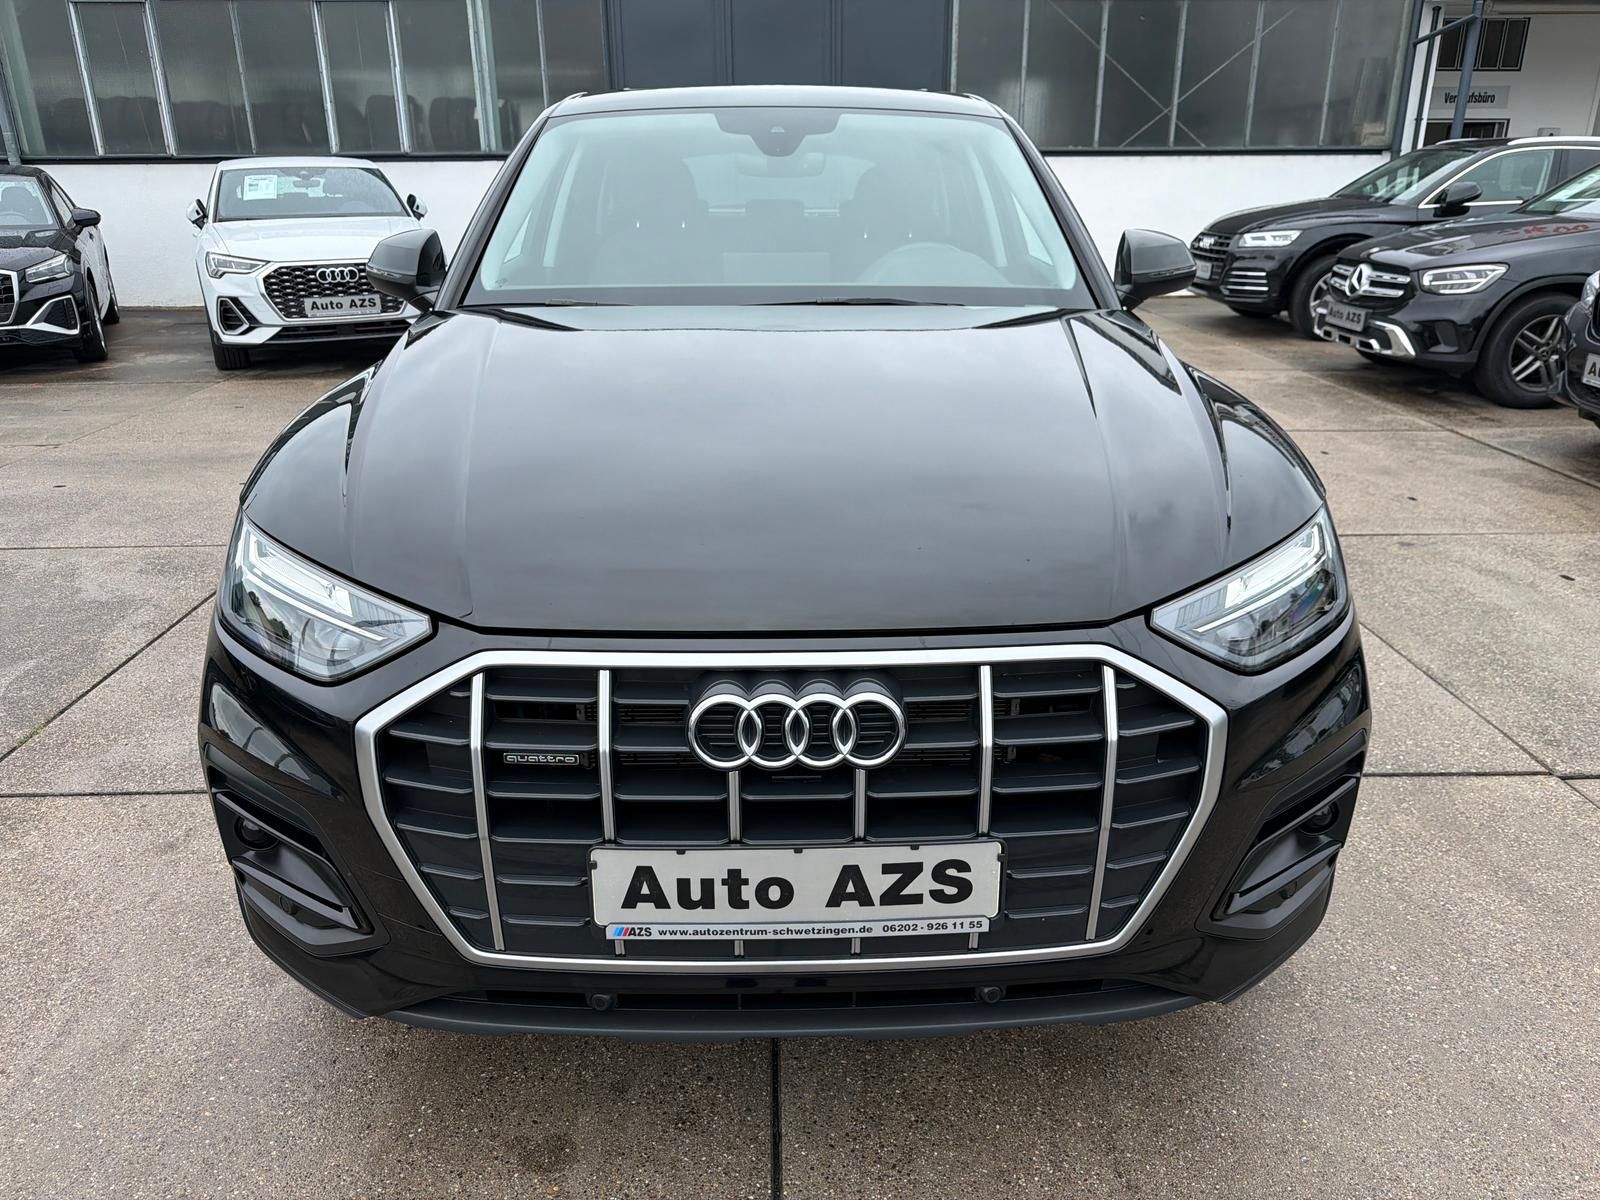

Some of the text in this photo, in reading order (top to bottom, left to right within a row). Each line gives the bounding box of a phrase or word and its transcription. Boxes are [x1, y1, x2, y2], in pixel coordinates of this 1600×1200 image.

[311, 298, 377, 311] Auto AZS
[506, 755, 575, 763] quattro
[620, 858, 974, 910] Auto AZS
[628, 927, 652, 937] AZS
[657, 926, 873, 937] www.autozentrum-schwetzingen.de
[882, 923, 918, 933] 06202
[926, 922, 948, 931] 926
[951, 921, 965, 930] 11
[968, 920, 983, 929] 55
